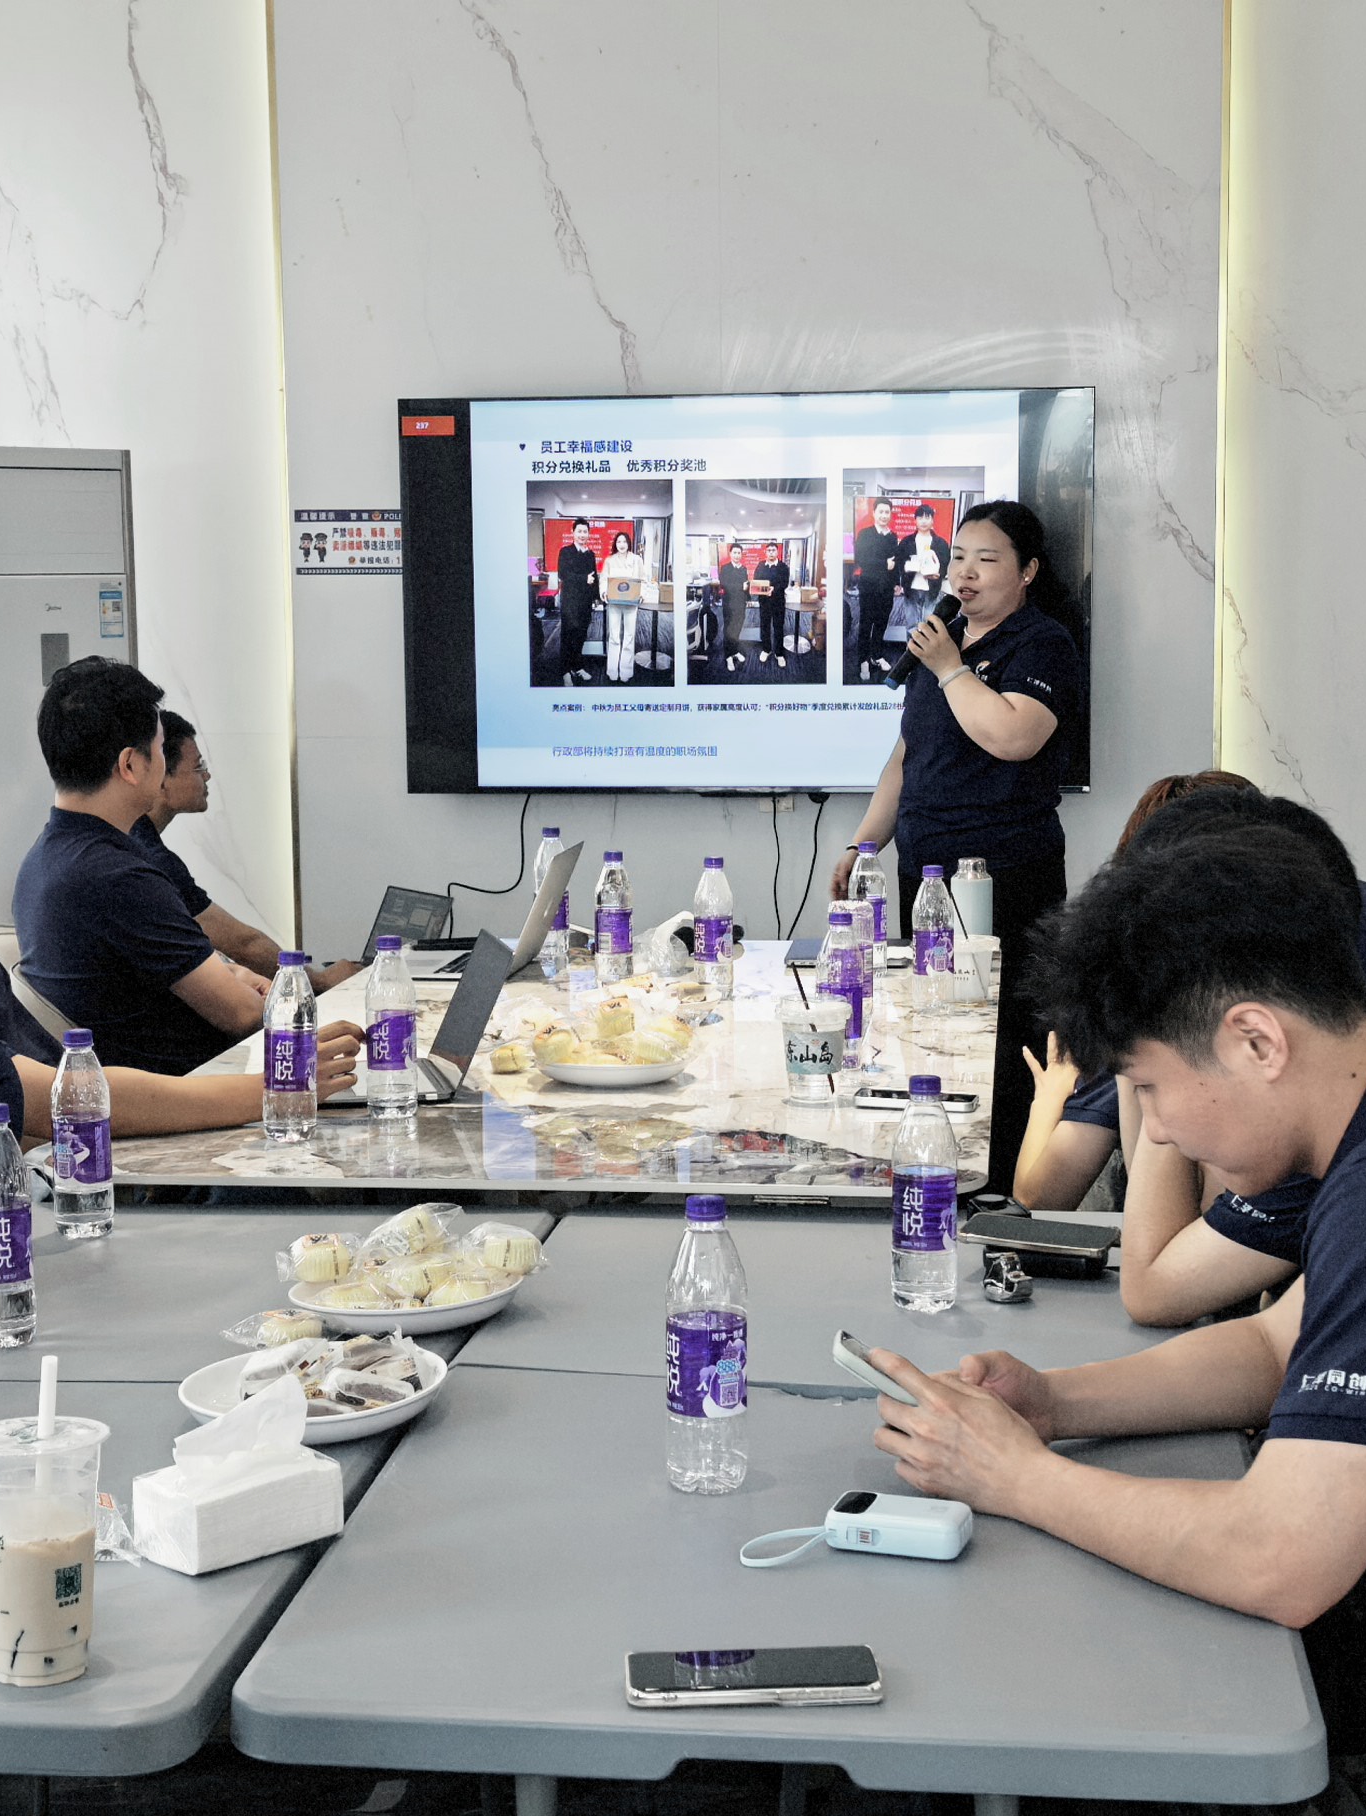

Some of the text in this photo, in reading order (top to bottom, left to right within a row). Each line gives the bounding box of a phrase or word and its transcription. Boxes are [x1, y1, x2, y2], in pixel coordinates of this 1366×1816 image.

[540, 439, 633, 454] 员工幸福感建设
[531, 459, 707, 474] 积分兑换礼品 优秀积分奖池
[274, 1039, 295, 1081] 纯悦
[902, 1186, 924, 1238] 纯悦
